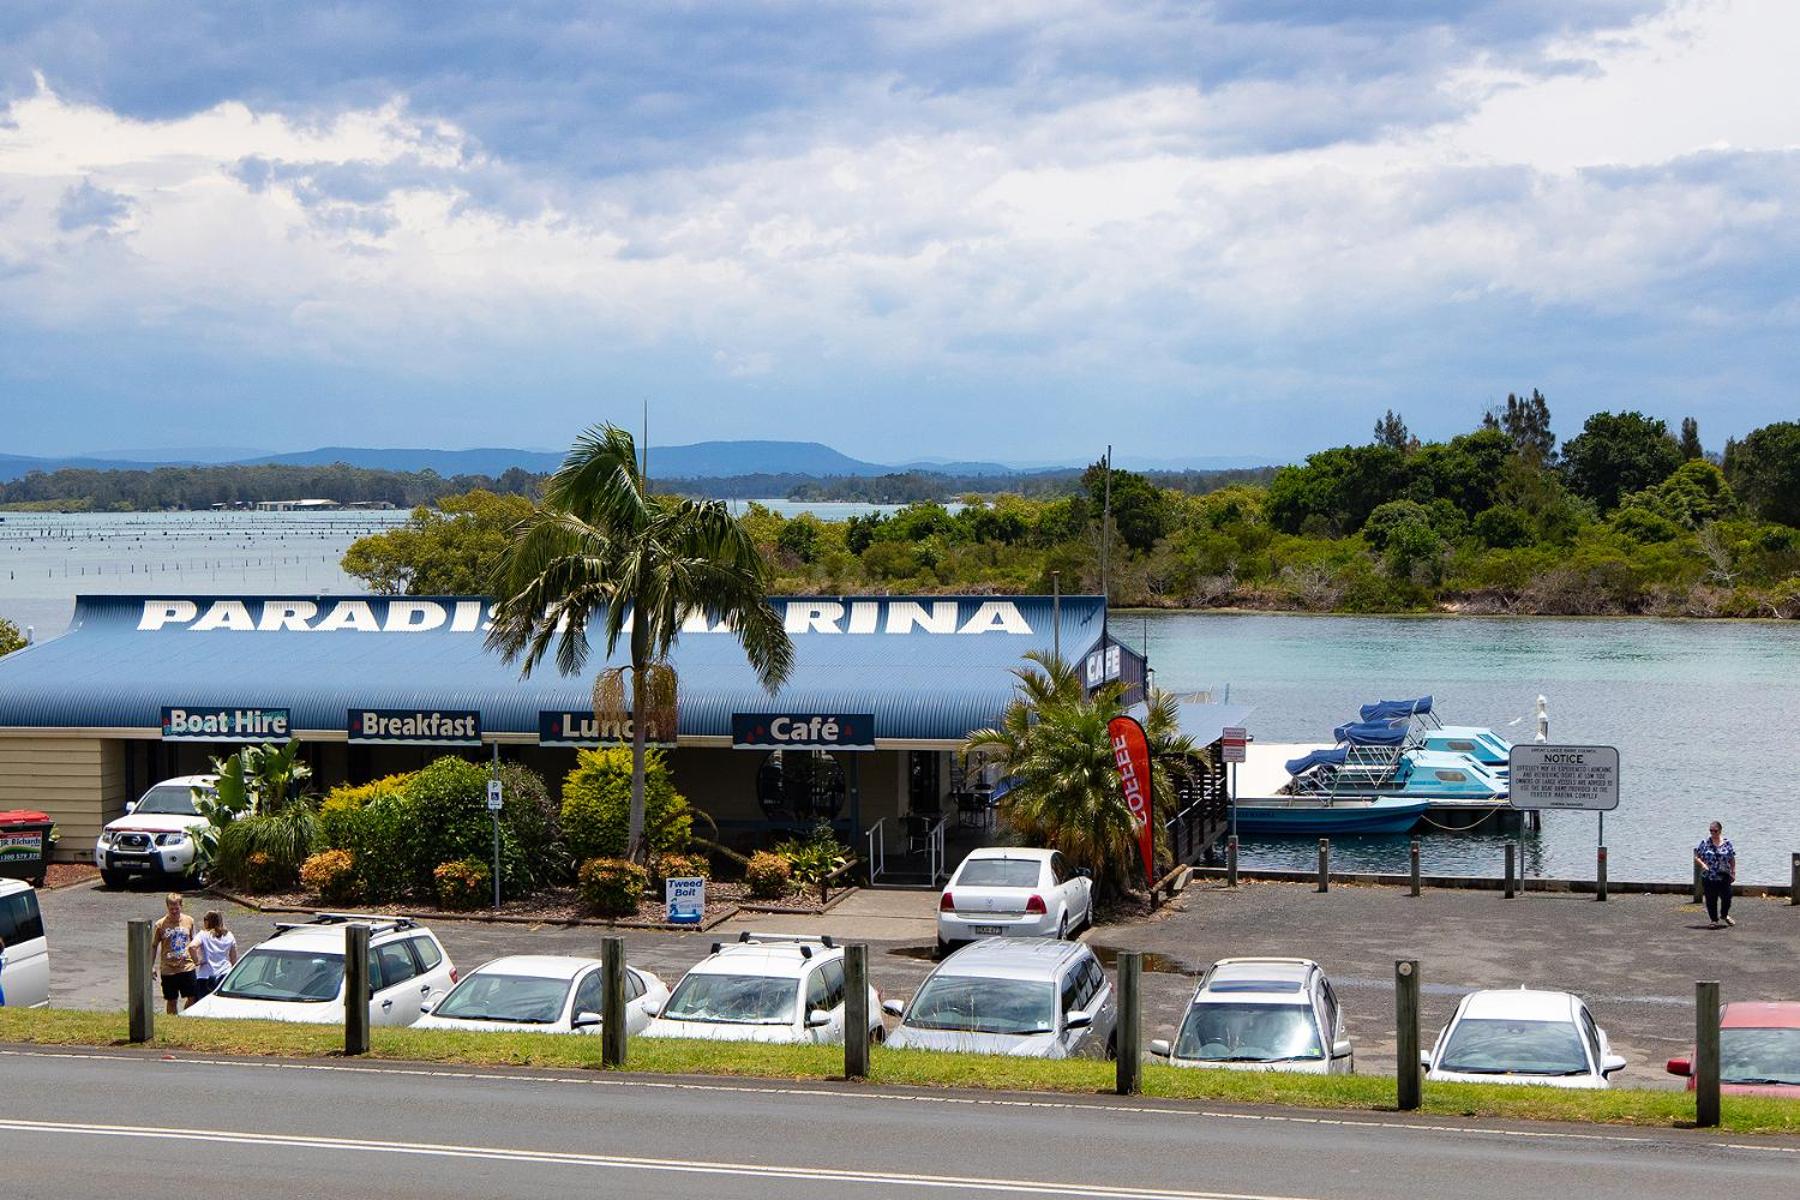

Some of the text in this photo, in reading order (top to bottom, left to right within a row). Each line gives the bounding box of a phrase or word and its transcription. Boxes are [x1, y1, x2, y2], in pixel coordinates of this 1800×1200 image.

[620, 600, 1034, 634] RINA
[170, 709, 288, 735] Boat Hire
[362, 711, 475, 737] Breakfast
[769, 715, 839, 742] Café
[1544, 755, 1584, 763] NOTICE
[668, 879, 703, 888] Tweed
